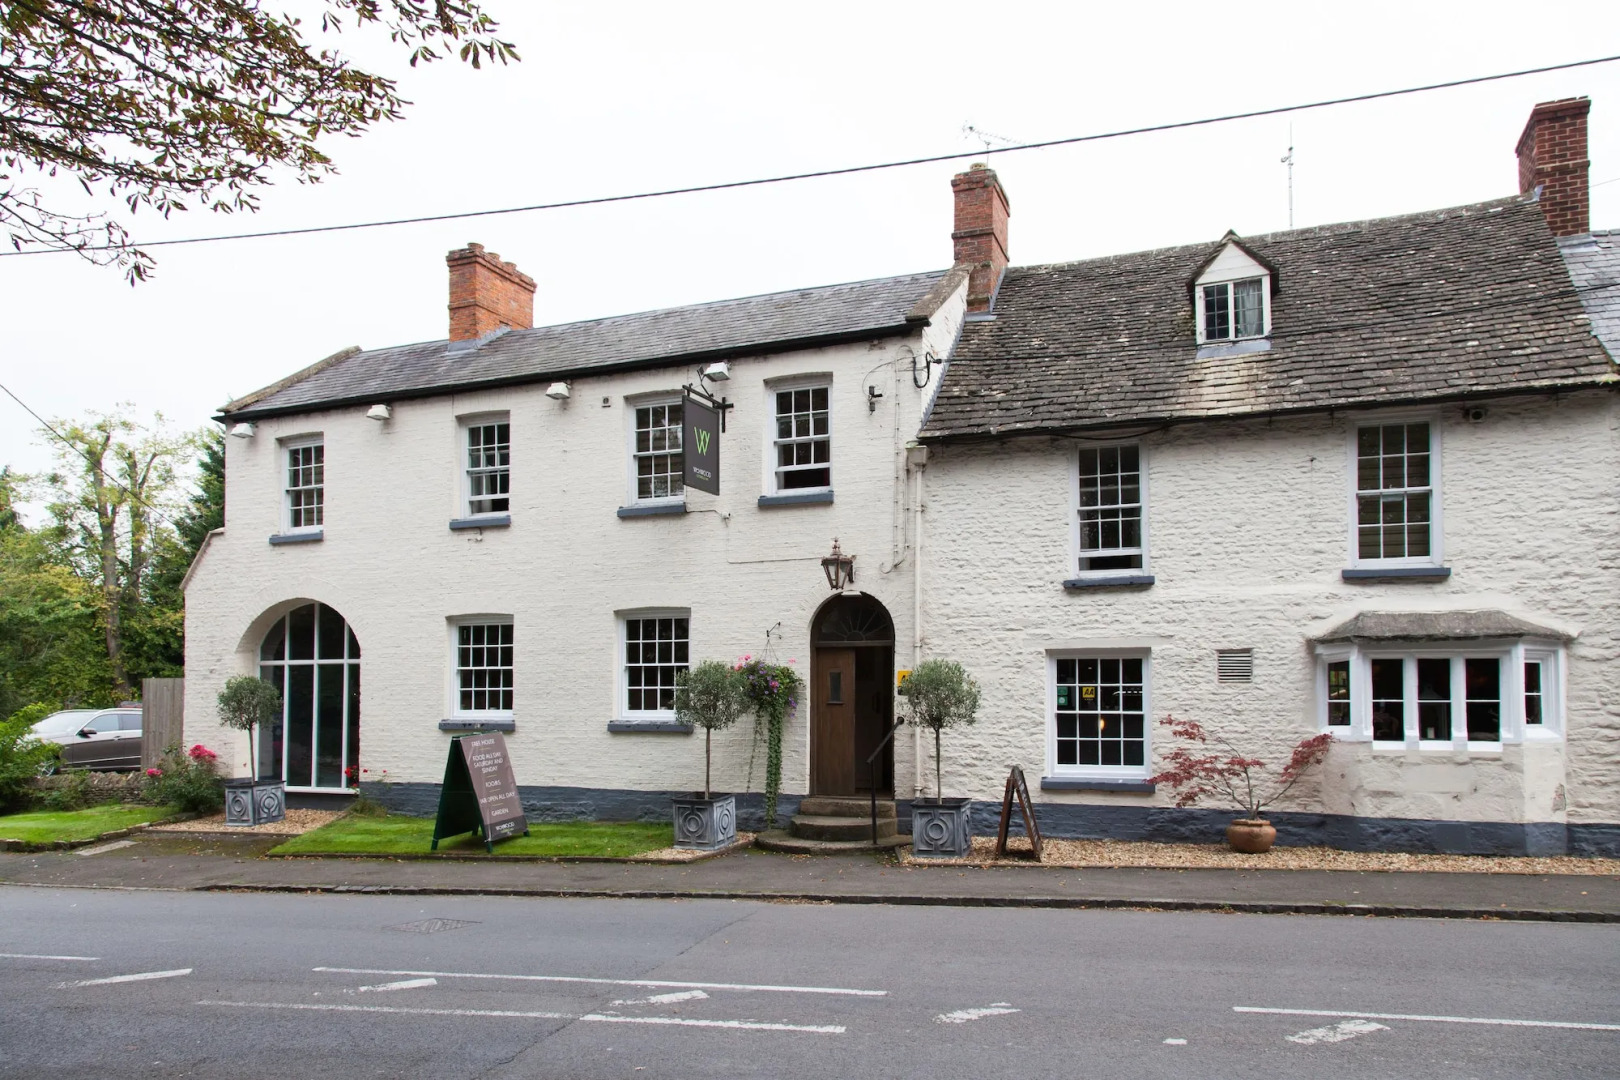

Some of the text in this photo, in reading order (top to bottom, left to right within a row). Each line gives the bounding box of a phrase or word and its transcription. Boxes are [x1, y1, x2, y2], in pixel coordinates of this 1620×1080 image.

[1084, 688, 1094, 696] AA
[473, 760, 493, 768] SATURDAY
[491, 808, 509, 816] GARDEN
